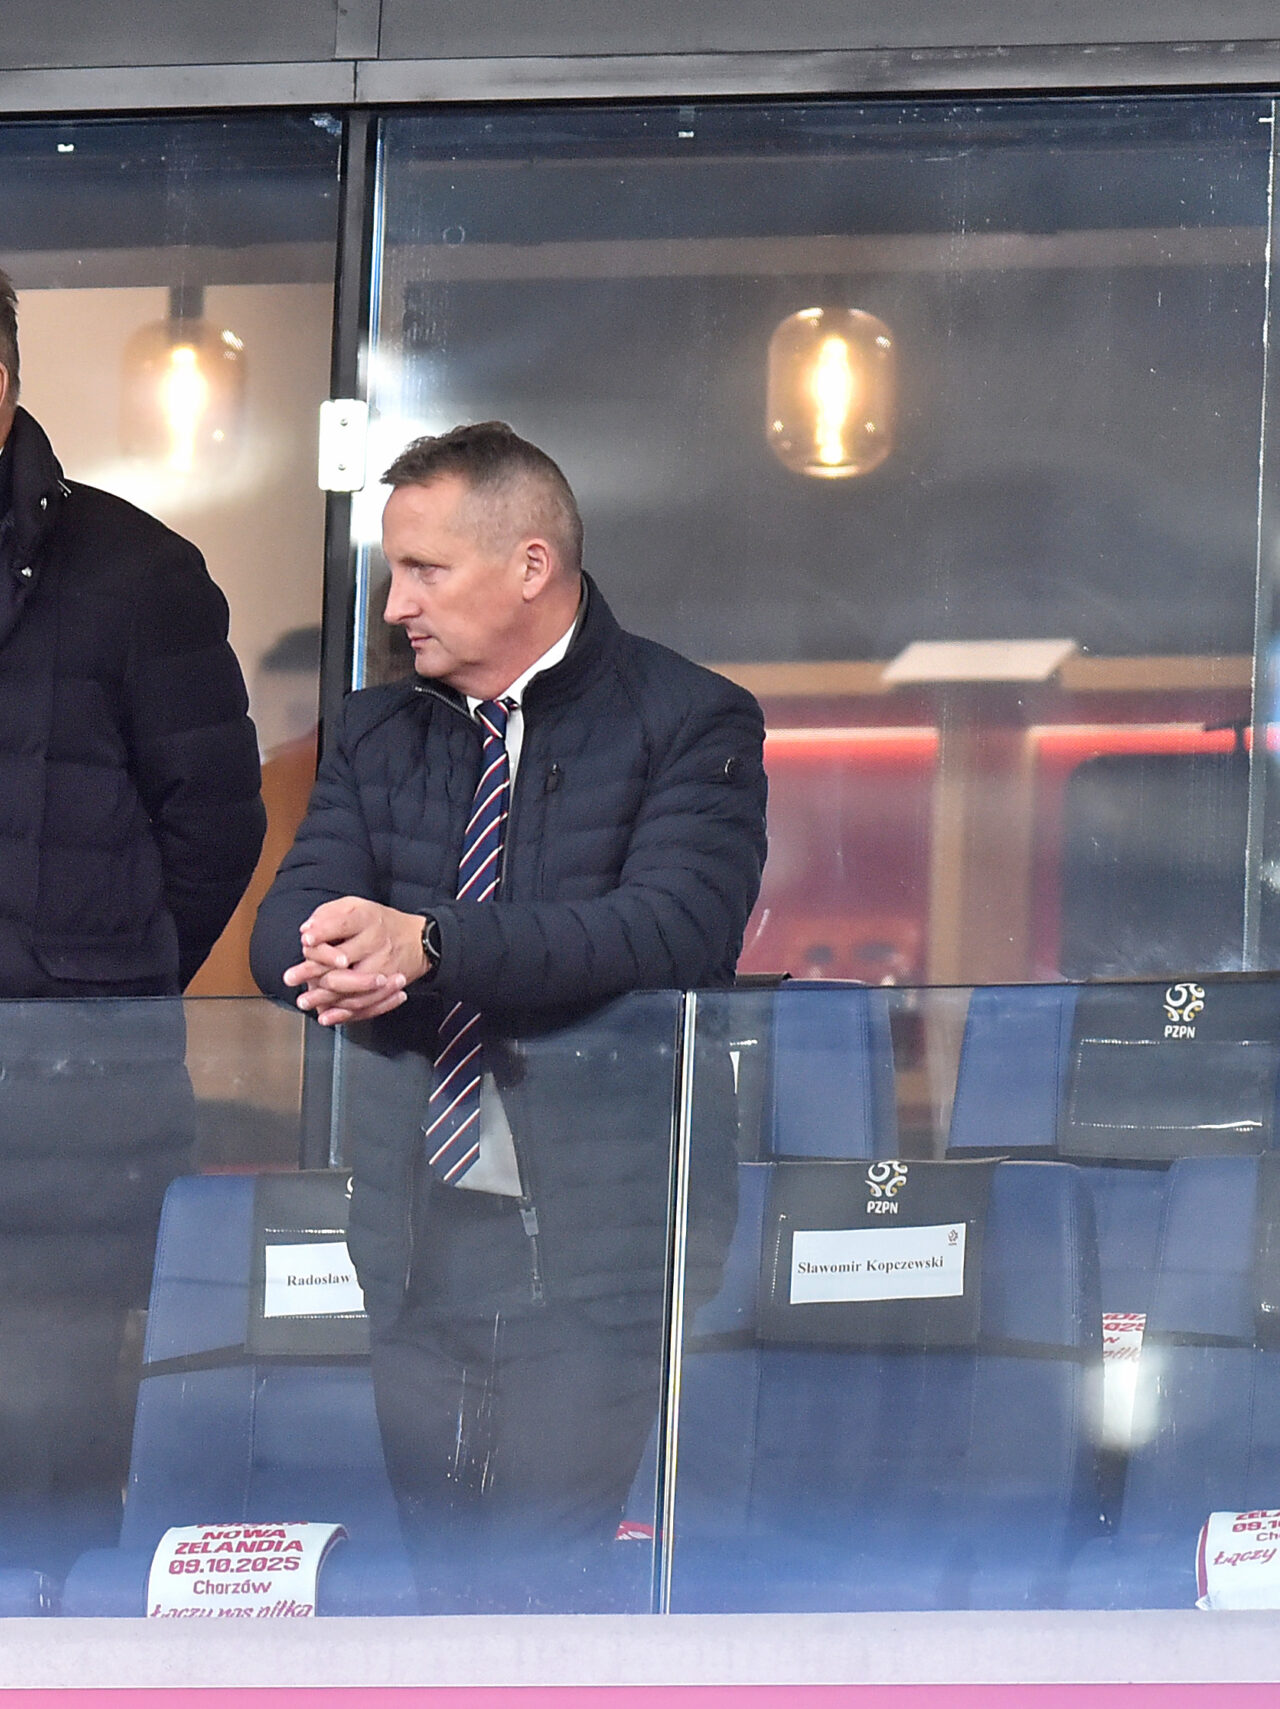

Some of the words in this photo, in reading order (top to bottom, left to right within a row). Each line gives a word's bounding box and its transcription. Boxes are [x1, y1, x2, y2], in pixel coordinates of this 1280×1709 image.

[1164, 1025, 1196, 1038] PZPN
[867, 1201, 899, 1214] PZPN
[866, 1256, 944, 1274] Kopczewski
[202, 1529, 286, 1540] NOWA
[175, 1540, 303, 1555] ZELANDIA
[169, 1557, 301, 1575] 09.10.2025
[193, 1578, 272, 1594] Chorzów
